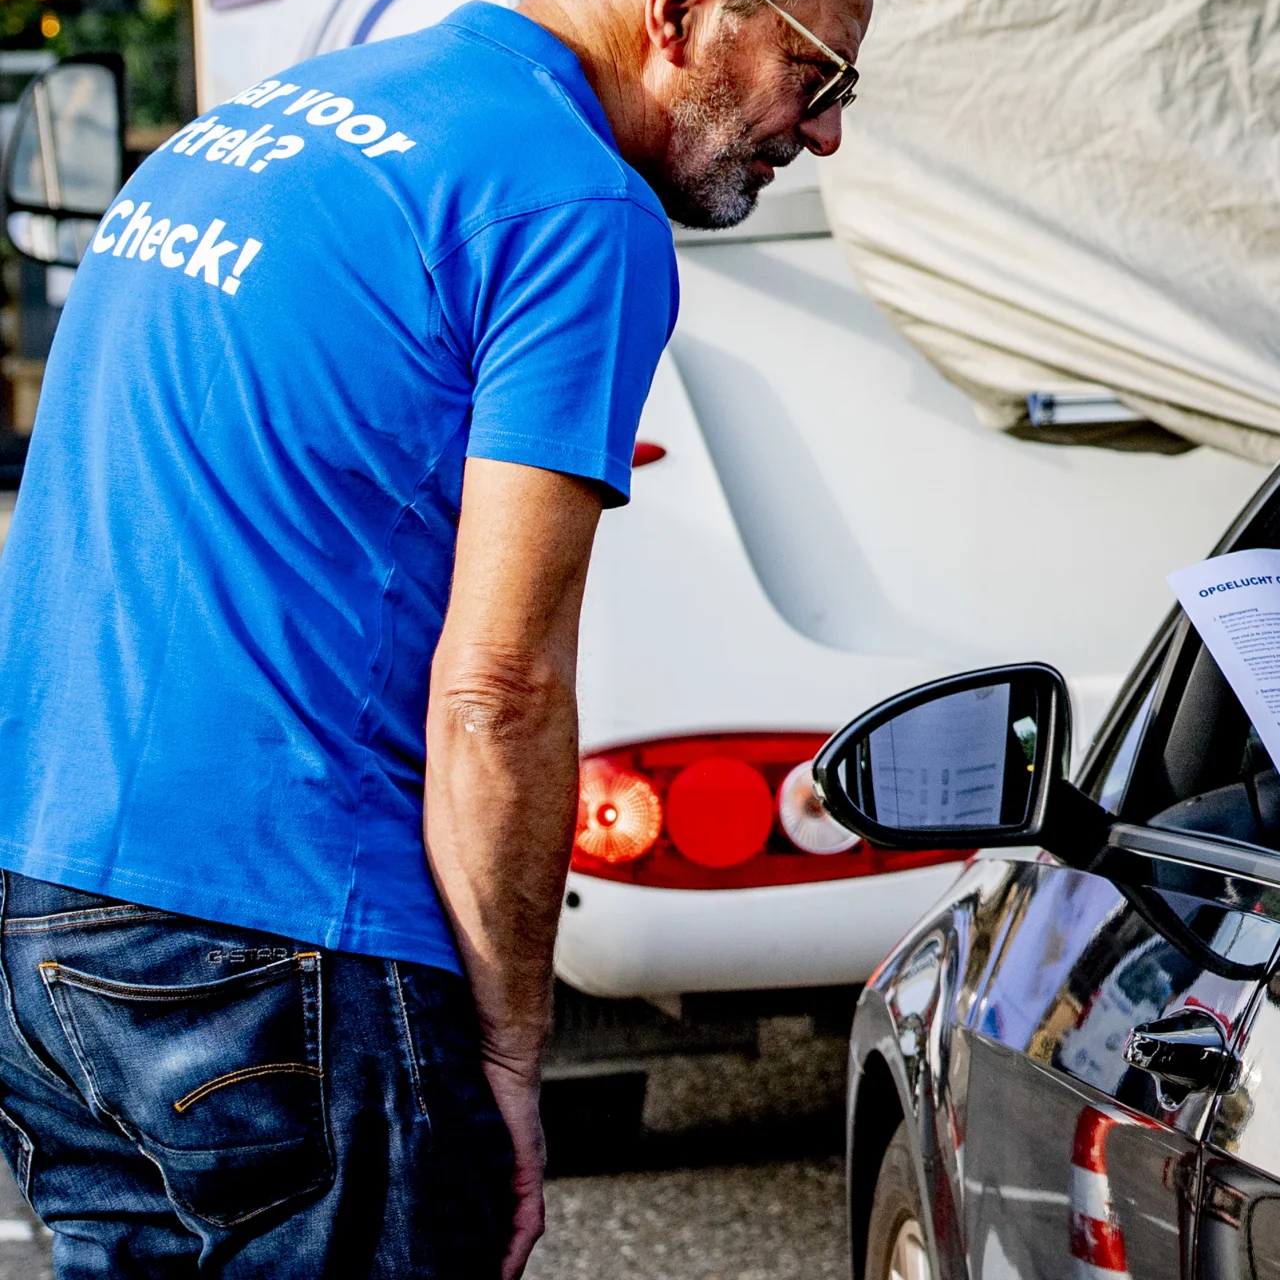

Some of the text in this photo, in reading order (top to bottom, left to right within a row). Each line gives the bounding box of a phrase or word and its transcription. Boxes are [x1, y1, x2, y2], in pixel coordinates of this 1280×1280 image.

[282, 88, 418, 158] voor
[92, 199, 263, 297] Check!
[1198, 575, 1273, 598] OPGELUCHT
[206, 947, 288, 964] G-STAR
